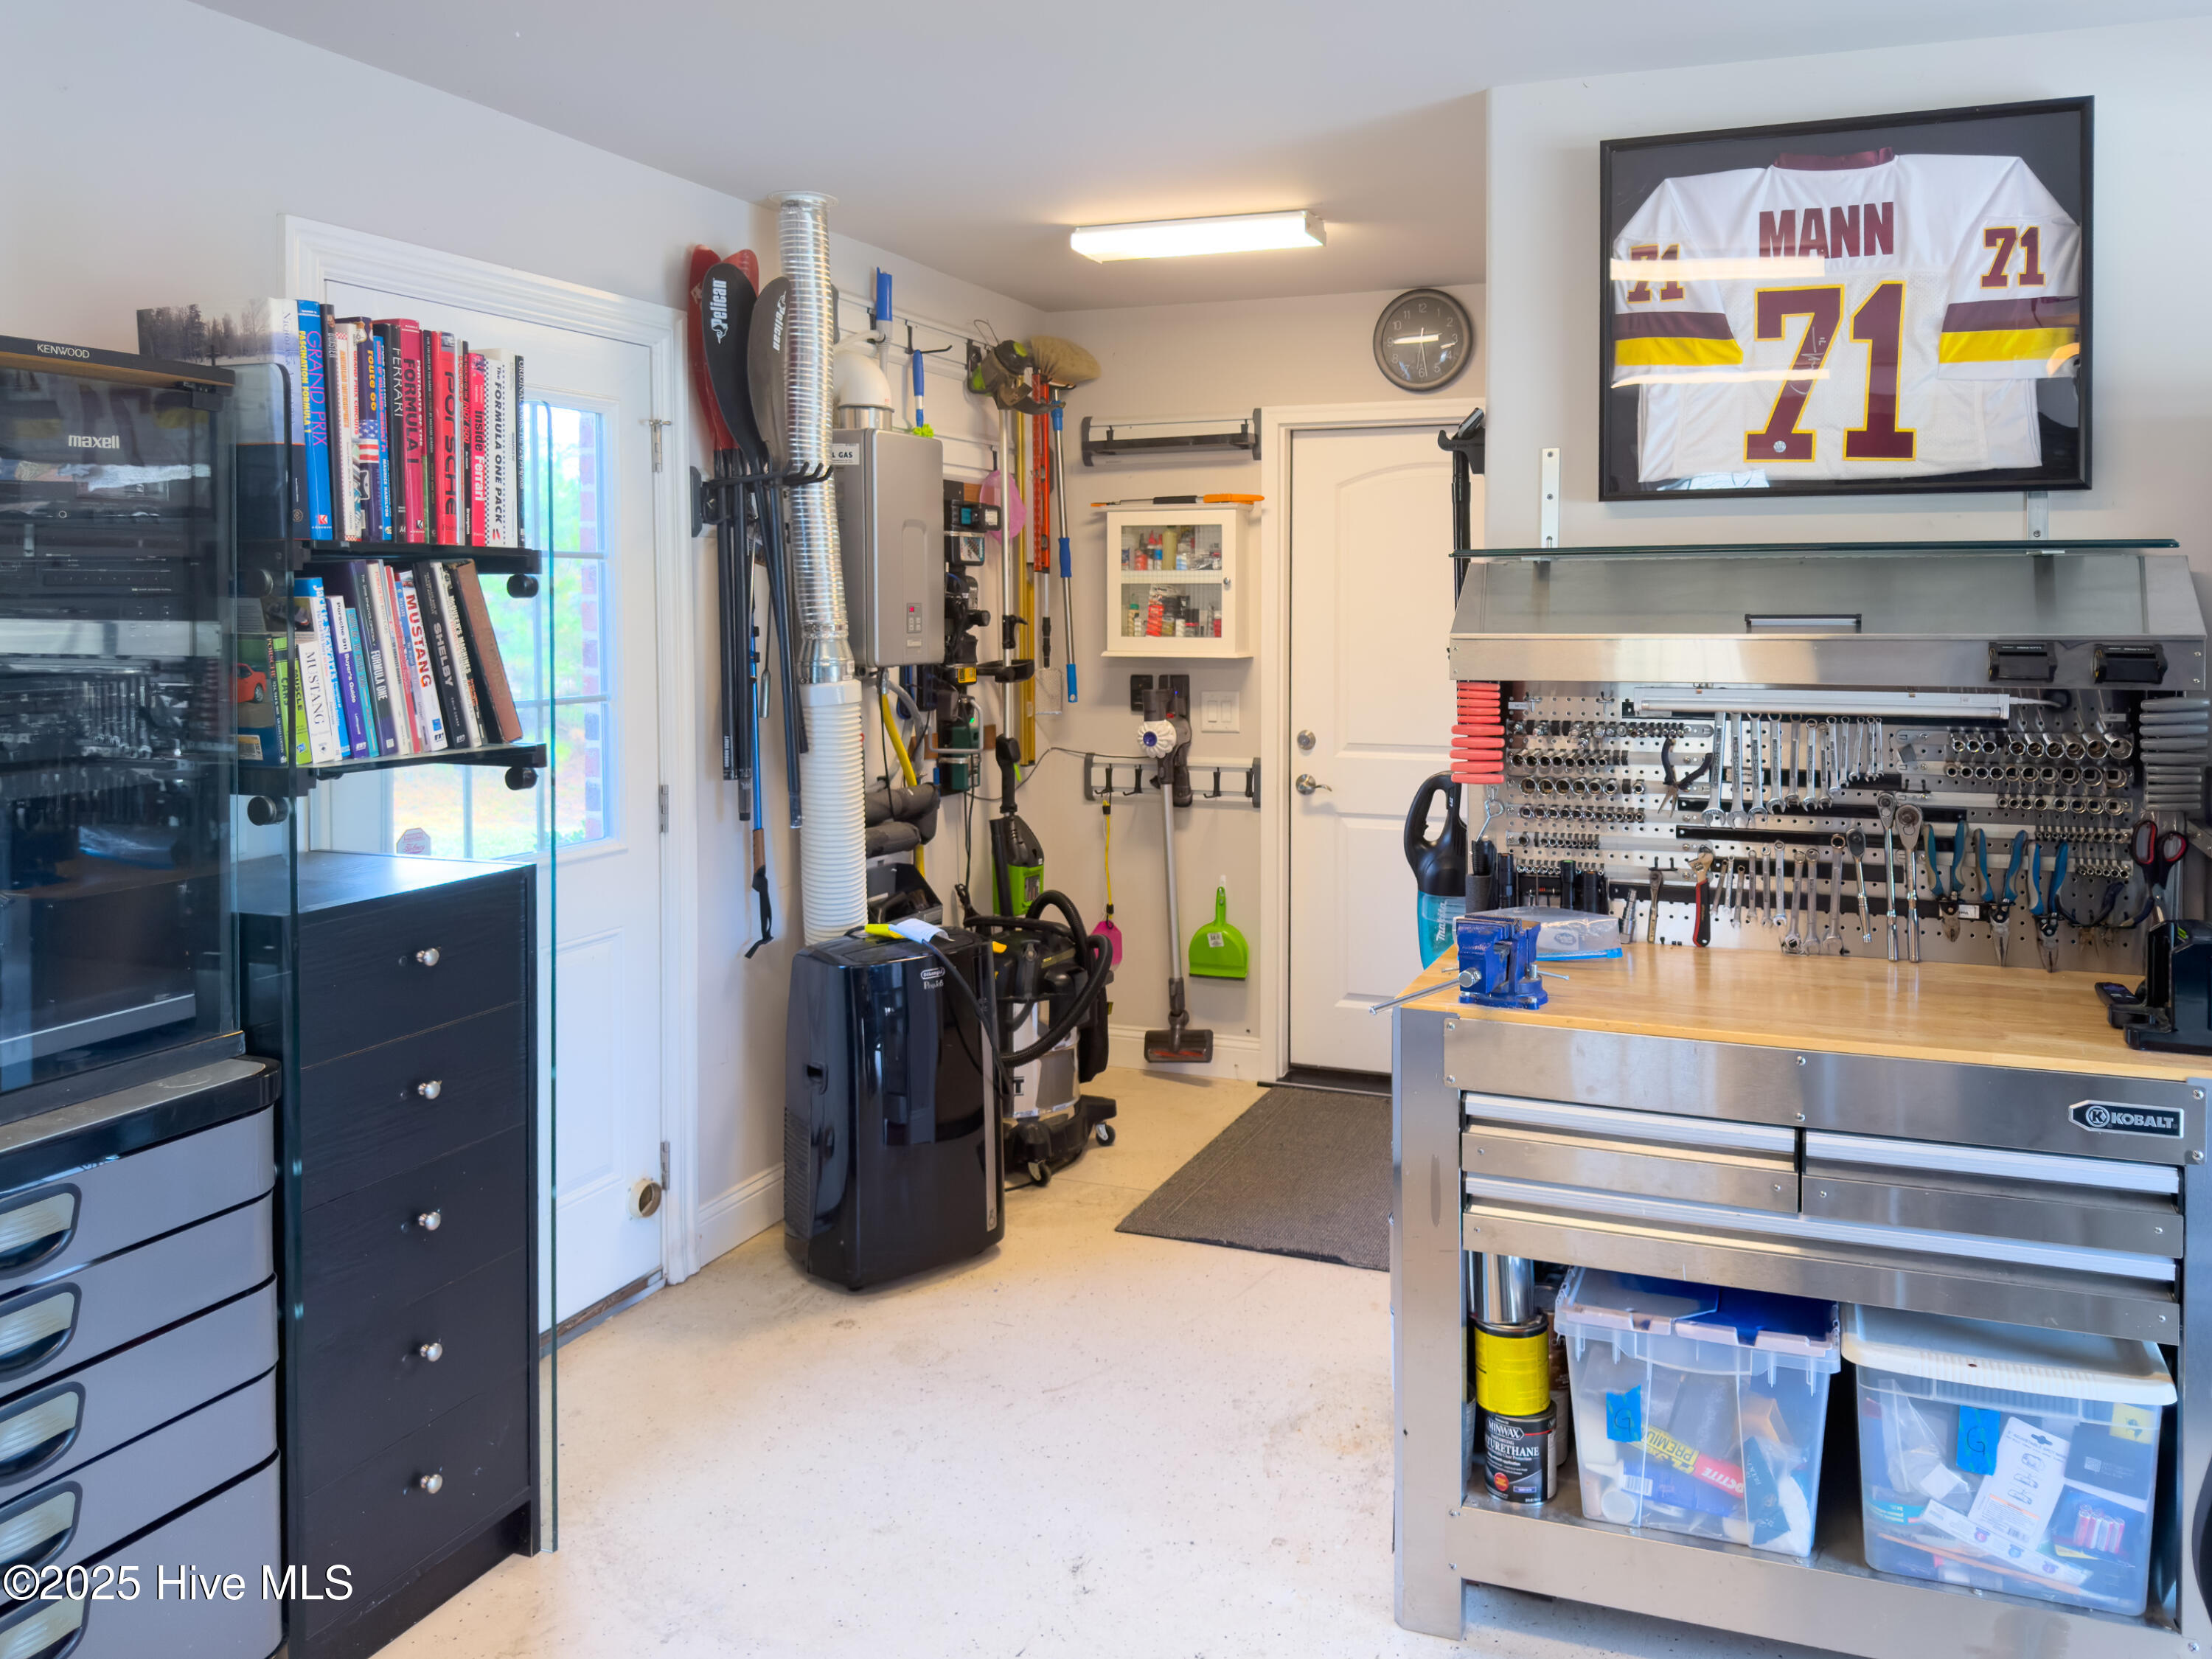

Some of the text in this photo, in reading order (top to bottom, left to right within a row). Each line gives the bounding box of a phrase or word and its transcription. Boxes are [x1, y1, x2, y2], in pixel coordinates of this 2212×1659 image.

[1759, 201, 1893, 259] MANN
[1980, 226, 2045, 289] 71
[1627, 243, 1685, 303] 71
[710, 278, 728, 339] Pelican
[773, 292, 786, 351] Pelican
[37, 344, 90, 358] KENWOOD
[299, 330, 309, 383] FASCINATION
[306, 330, 325, 404] GRAND
[1743, 280, 1916, 463] 71
[302, 386, 311, 425] FORMULA
[392, 347, 403, 417] FERRARI
[403, 358, 419, 451] FORMULA
[68, 434, 120, 449] maxell
[311, 411, 327, 445] PRIX
[445, 372, 456, 515] PORSCHE
[474, 411, 484, 501] inside Ferrari
[336, 602, 345, 636] Porsche
[344, 653, 352, 681] Buyer's
[406, 594, 431, 688] MUSTANG
[434, 622, 453, 686] SHELBY
[458, 636, 472, 675] MACHINES
[307, 652, 324, 724] MUSTANG
[371, 650, 388, 701] FORMULA ONE
[2110, 1112, 2174, 1129] KOBALT
[1488, 1419, 1519, 1439] MINWAX
[1966, 1425, 1986, 1456] G
[1701, 1466, 1744, 1495] OCTITE
